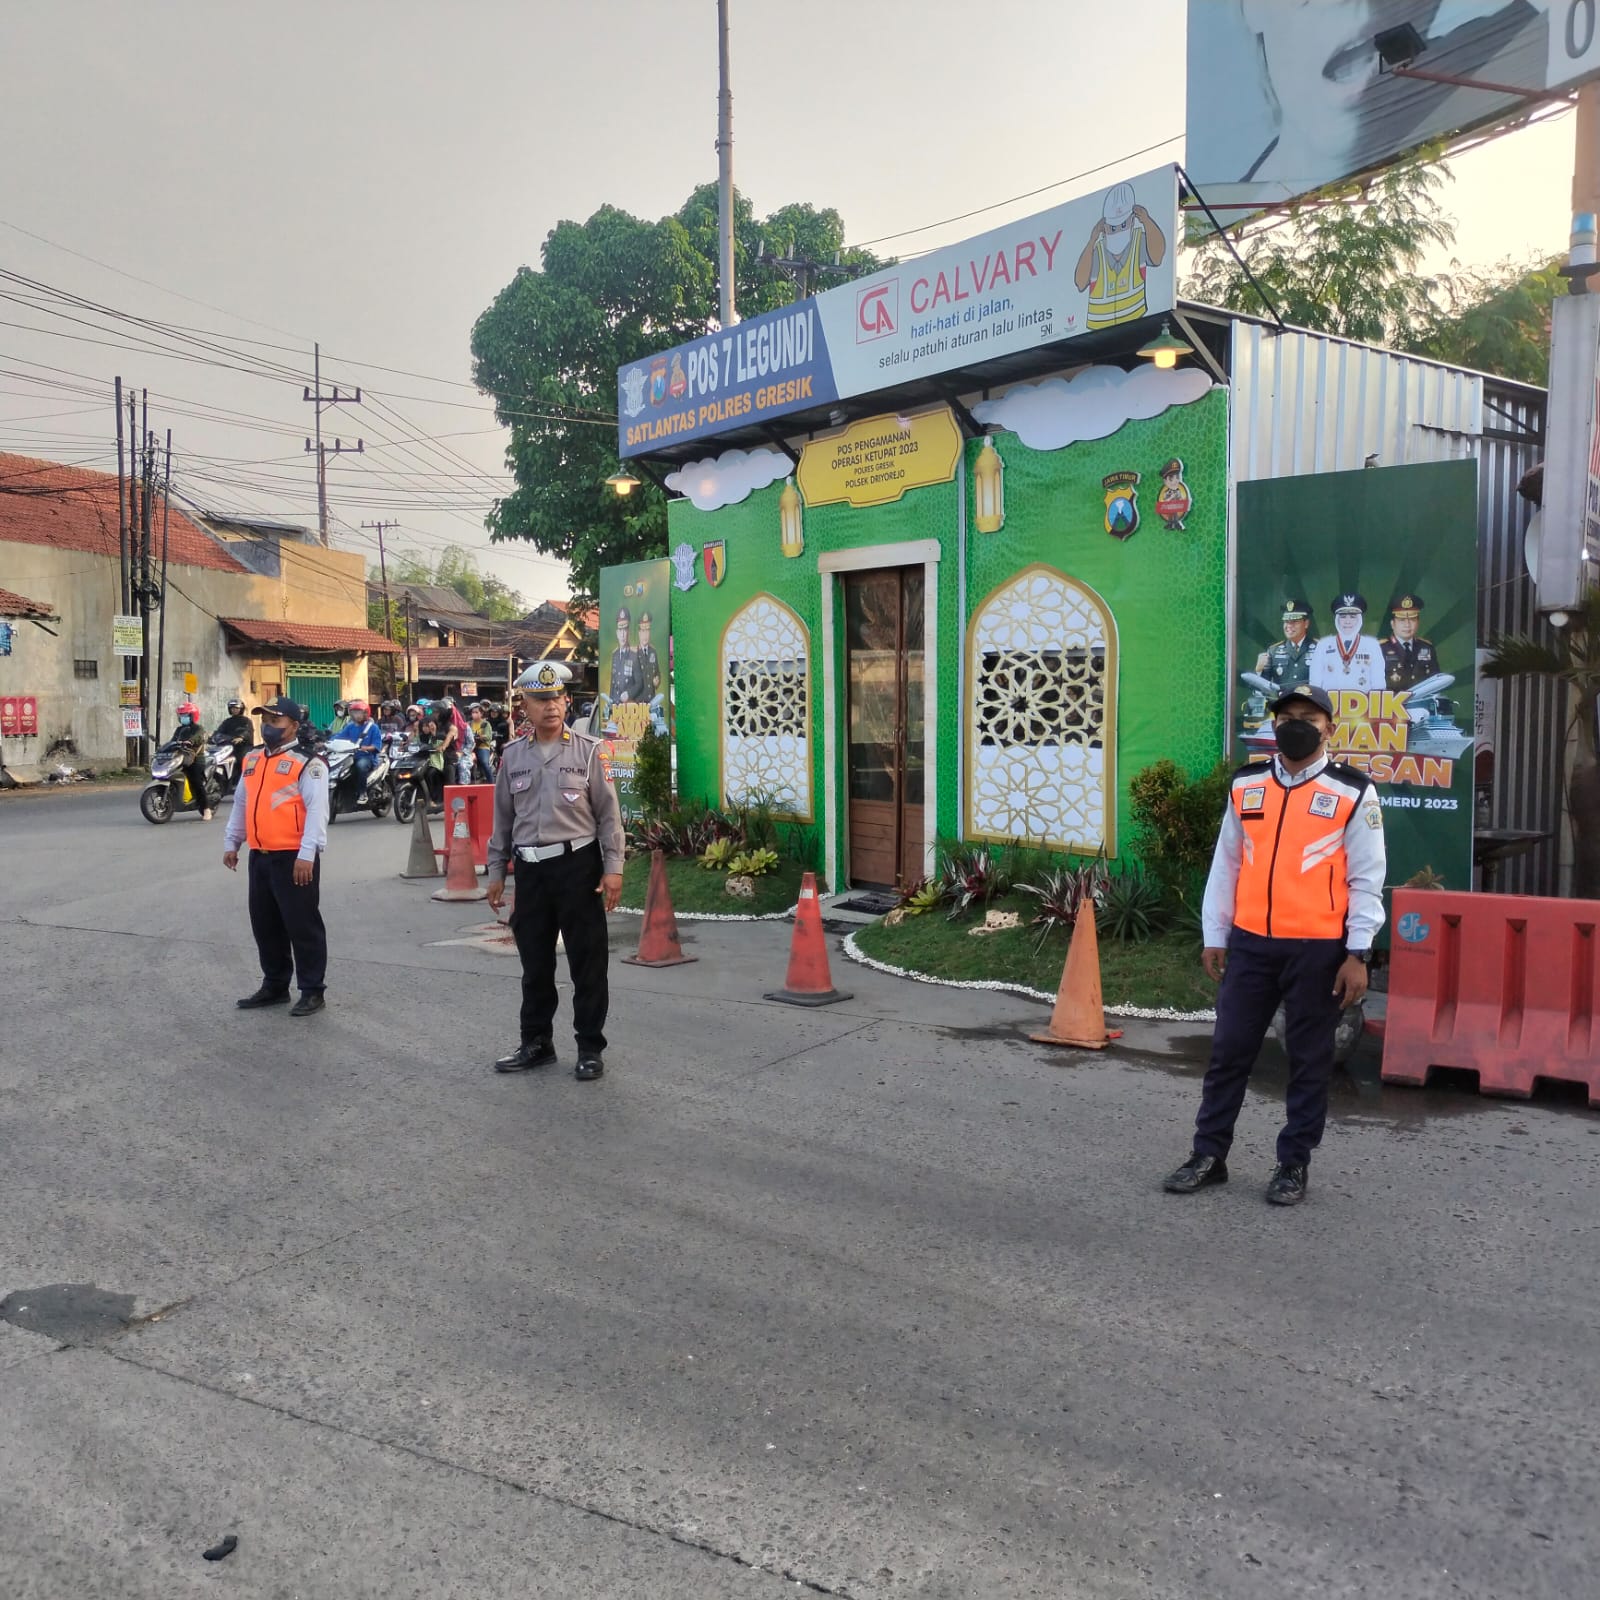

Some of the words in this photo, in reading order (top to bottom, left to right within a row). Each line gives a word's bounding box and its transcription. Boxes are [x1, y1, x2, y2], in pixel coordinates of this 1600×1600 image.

[910, 230, 1064, 314] CALVARY
[911, 312, 960, 339] hati-hati
[964, 307, 975, 322] di
[977, 298, 1014, 322] jalan,
[878, 348, 910, 369] selalu
[912, 337, 948, 363] patuhi
[951, 329, 988, 350] aturan
[992, 319, 1014, 338] lalu
[1017, 307, 1053, 331] lintas
[688, 342, 719, 398] POS
[722, 337, 733, 387] 7
[737, 309, 814, 383] LEGUNDI
[627, 410, 696, 446] SATLANTAS
[699, 392, 752, 427] POLRES
[756, 376, 813, 410] GRESIK
[832, 455, 862, 470] OPERASI
[865, 446, 897, 463] KETUPAT
[899, 441, 919, 455] 2023
[837, 444, 852, 456] POS
[855, 430, 911, 450] PENGAMANAN
[845, 478, 868, 488] POLSEK
[870, 469, 906, 484] DRIYOREJO
[854, 465, 874, 475] POLRES
[876, 461, 895, 471] GRESIK
[560, 767, 586, 776] POLRI
[1424, 798, 1458, 810] 2023
